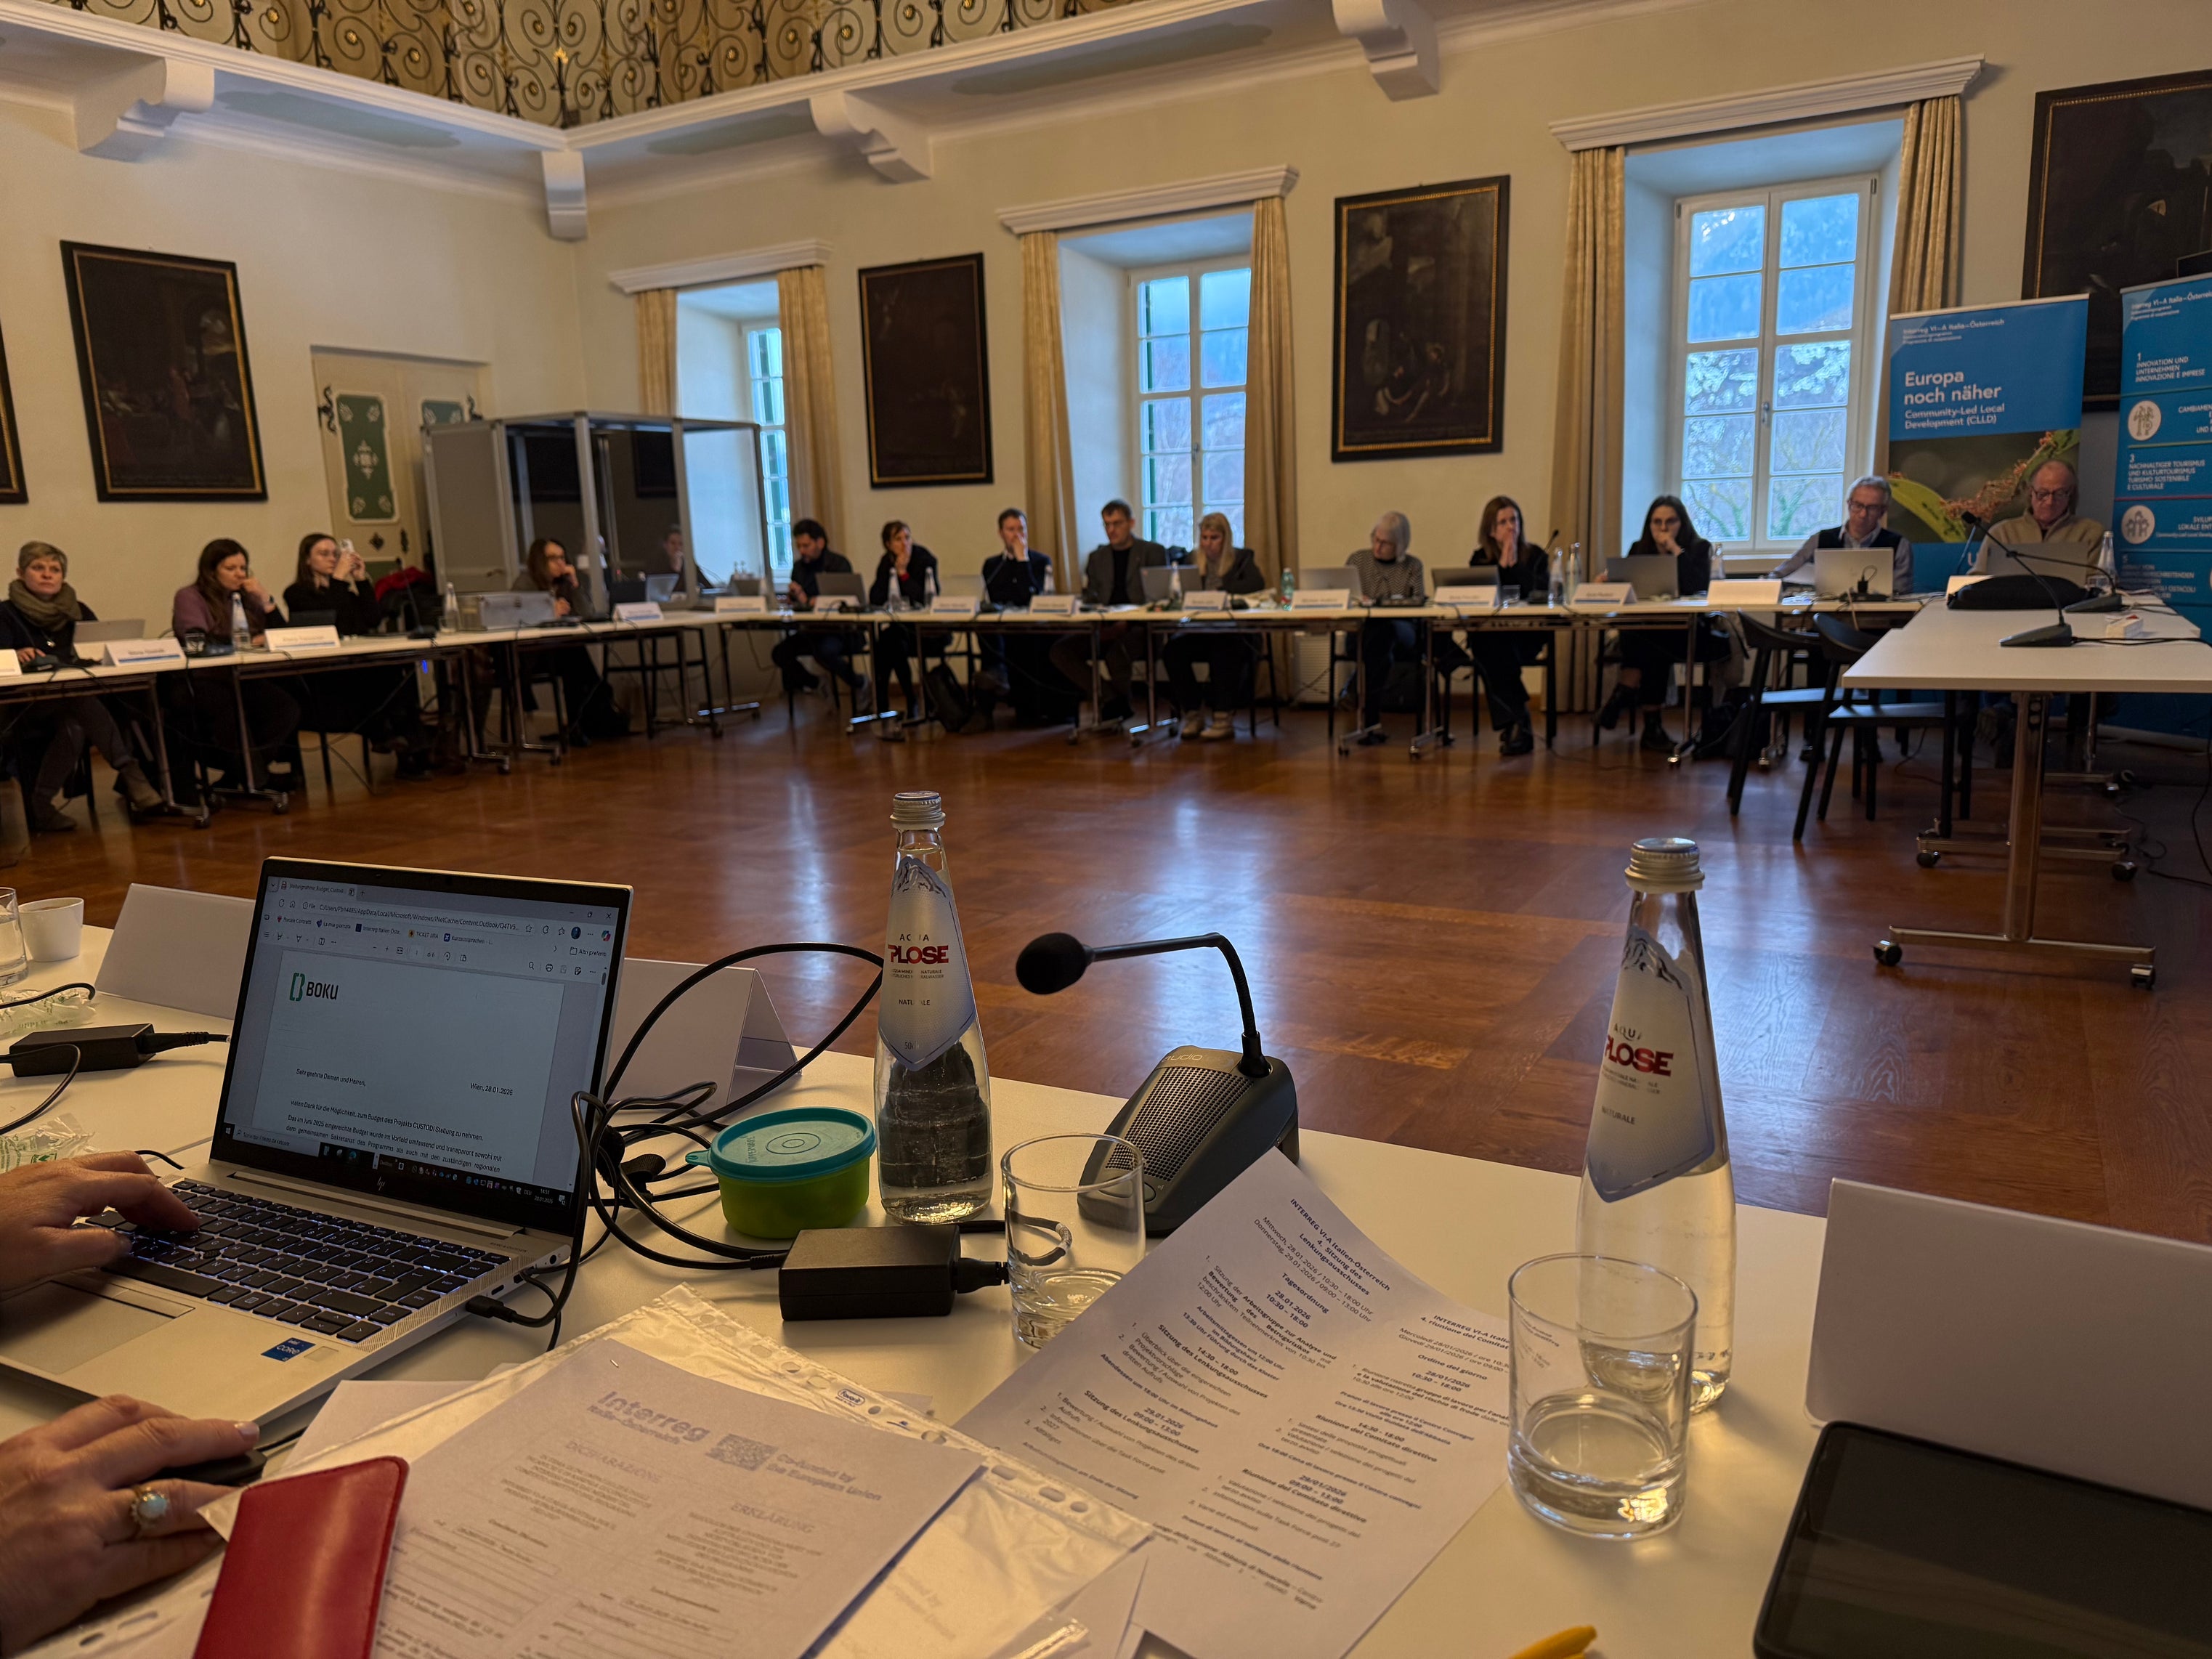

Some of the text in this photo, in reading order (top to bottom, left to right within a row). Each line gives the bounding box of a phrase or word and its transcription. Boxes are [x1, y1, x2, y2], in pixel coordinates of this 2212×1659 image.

[2136, 365, 2180, 376] UNTERNEHMEN
[2137, 357, 2173, 368] INNOVATION
[2182, 368, 2205, 377] IMPRESE
[1904, 384, 2002, 405] noch näher
[1905, 371, 1964, 387] Europa
[1905, 402, 2005, 419] Community-Led Local
[1905, 414, 1996, 429] Development (CLLD)
[2130, 453, 2135, 463] 3
[888, 944, 949, 965] PLOSE
[305, 981, 339, 1001] BOKU
[306, 1069, 323, 1080] geehrte
[323, 1072, 340, 1082] Damen
[348, 1076, 367, 1087] Herren,
[469, 1082, 514, 1096] Wien, 28.01.2026
[290, 1099, 304, 1108] vielen
[303, 1101, 316, 1110] Dank
[329, 1106, 357, 1119] Möglichkeit,
[366, 1113, 384, 1124] Budget
[383, 1116, 394, 1124] des
[392, 1118, 413, 1129] Projekts
[412, 1121, 435, 1132] CUSTODI
[434, 1125, 455, 1137] Stellung
[297, 1127, 329, 1140] gemeinsamen
[330, 1133, 355, 1144] Sekretariat
[367, 1140, 394, 1153] Programms
[441, 1156, 472, 1168] zuständigen
[473, 1161, 501, 1174] regionalen
[312, 1119, 325, 1127] 2025
[323, 1121, 352, 1134] eingereichte
[352, 1127, 369, 1137] Budget
[368, 1129, 384, 1139] wurde
[391, 1134, 408, 1143] Vorfeld
[408, 1137, 435, 1148] umfassend
[445, 1144, 474, 1157] transparent
[474, 1150, 493, 1160] sowohl
[1289, 1198, 1392, 1292] INTERREG VI-A Italien-Österreich
[1316, 1238, 1363, 1281] 4. Sitzung des
[1252, 1217, 1372, 1323] Donnerstag, 29.01.2026 09:00 13:00 Uhr
[1261, 1216, 1374, 1316] Mittwoch, 28.01.2026 10:30 18:00 Uhr
[1297, 1232, 1371, 1297] Lenkungsausschusses
[1196, 1281, 1223, 1308] 12:00 Uhr
[1273, 1289, 1311, 1321] 28.01.2026
[1279, 1271, 1330, 1315] Tagesordnung
[1201, 1275, 1326, 1370] beschränktem Teilnehmerkreis von 10:30 bis
[1207, 1270, 1332, 1366] Bewertung des Betrugsrisikos mit
[1212, 1264, 1337, 1361] Sitzung der Arbeitsgruppe zur Analyse und
[1265, 1293, 1309, 1329] 10:30 18:00
[1433, 1314, 1472, 1332] INTERREG
[1472, 1328, 1489, 1338] VI-A
[1427, 1318, 1462, 1335] riunione
[1462, 1330, 1476, 1339] del
[1476, 1334, 1510, 1351] Comitat
[1156, 1322, 1269, 1400] Sitzung des Lenkungsausschusses
[1196, 1345, 1239, 1376] 14:30 18:00
[1417, 1352, 1488, 1382] Ordine del giorno
[1411, 1371, 1462, 1393] 10:30 18:00
[1425, 1368, 1471, 1390] 28/01/2026
[596, 1391, 710, 1443] Interreg
[1082, 1388, 1200, 1456] Sitzung des Lenkungsausschusses
[1143, 1406, 1186, 1430] 29.01.2026
[1314, 1412, 1438, 1464] Riunione del Comitato direttivo
